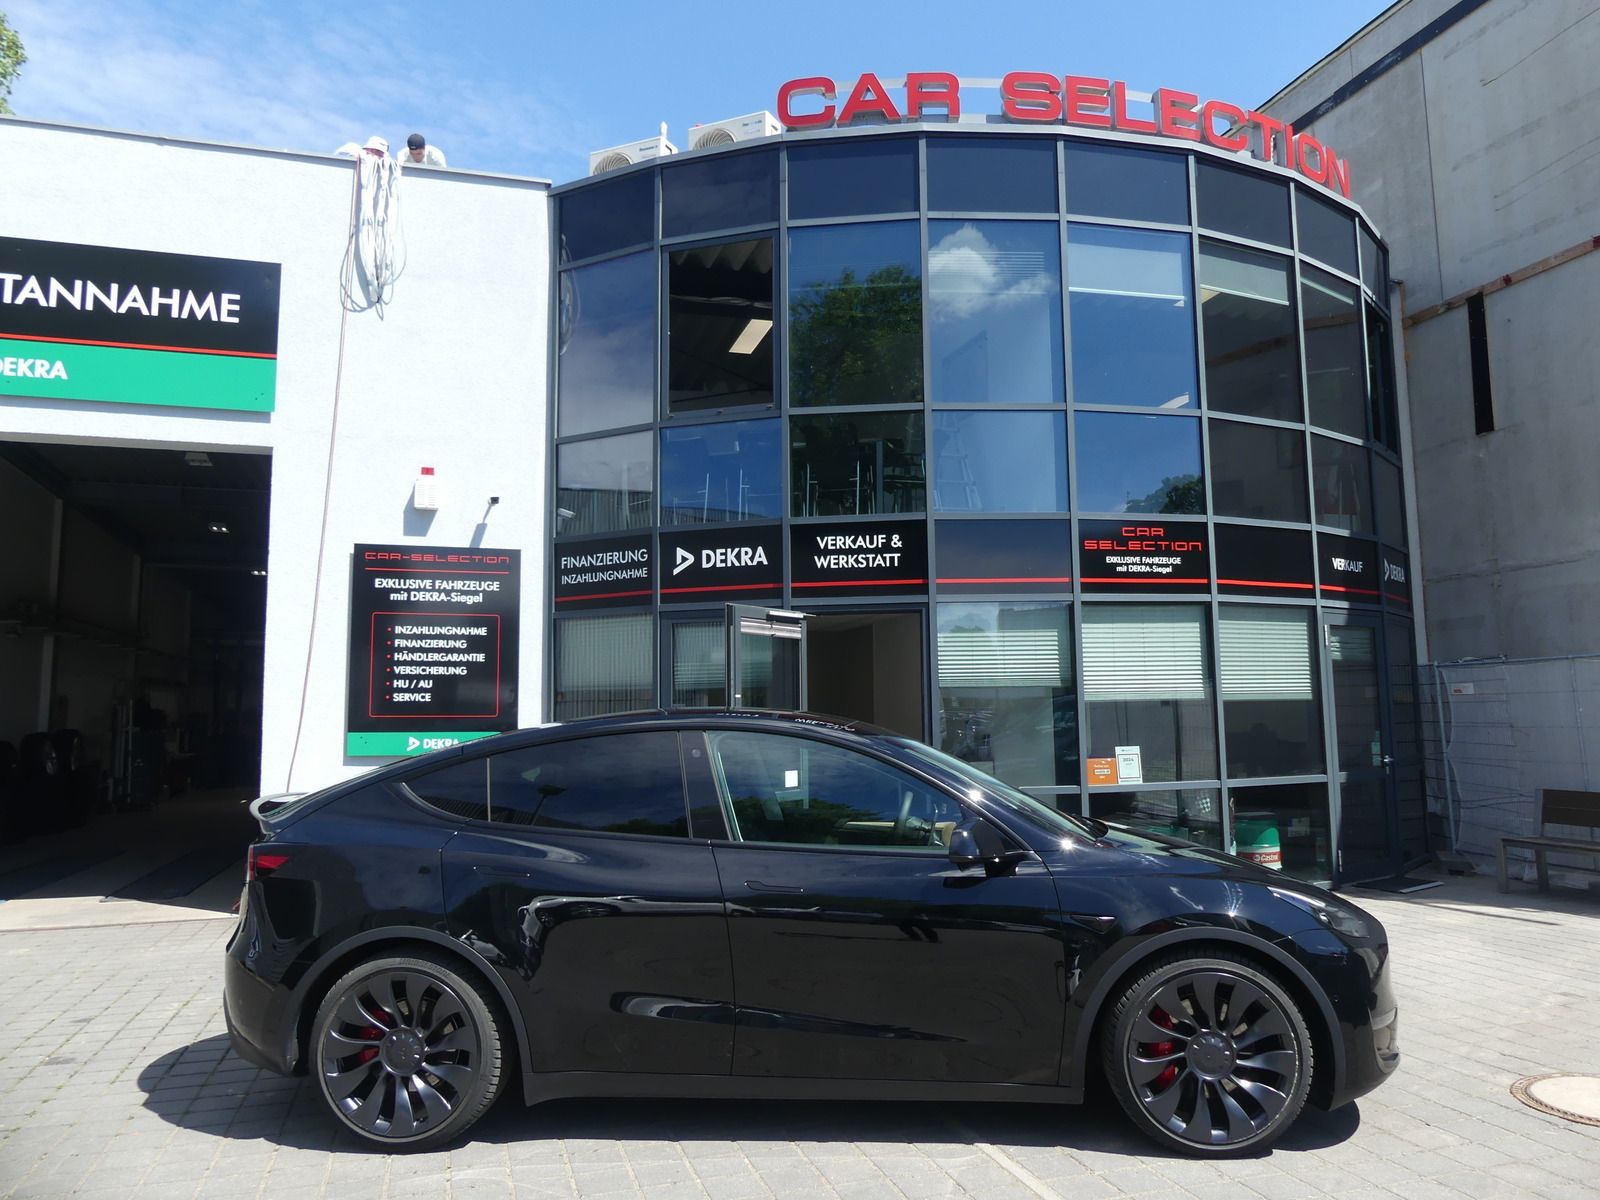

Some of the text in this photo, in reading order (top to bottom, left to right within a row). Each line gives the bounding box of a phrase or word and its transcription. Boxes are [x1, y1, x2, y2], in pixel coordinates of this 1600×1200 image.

[778, 72, 1352, 199] CAR SELECTION
[0, 272, 241, 323] TANNAHME
[0, 357, 68, 381] EKRA
[1121, 527, 1165, 537] CAR
[816, 534, 903, 550] VERKAUF &
[1084, 540, 1203, 551] SELECTION
[364, 552, 511, 564] CAR-SELECTION
[561, 548, 648, 570] FINANZIERUNG
[701, 546, 768, 568] DEKRA
[814, 553, 901, 569] WERKSTATT
[1106, 555, 1181, 566] EXKLUSIVE FAHRZEUGE
[1116, 564, 1173, 575] mit DEKRA-Siegel
[1331, 557, 1363, 573] VERKAUF
[561, 567, 648, 585] INZAHLUNGNAHME
[1389, 563, 1405, 583] DEKRA
[374, 577, 501, 592] EXKLUSIVE FAHRZEUGE
[389, 590, 484, 605] mit DEKRA-Siegel
[394, 625, 488, 636] INZAHLUNGNAHME
[394, 638, 468, 649] FINANZIERUNG
[394, 650, 486, 662] HÄNDLERGARANTIE
[393, 665, 468, 676] VERSICHERUNG
[393, 679, 409, 689] HU
[418, 679, 433, 689] AU
[392, 692, 432, 702] SERVICE
